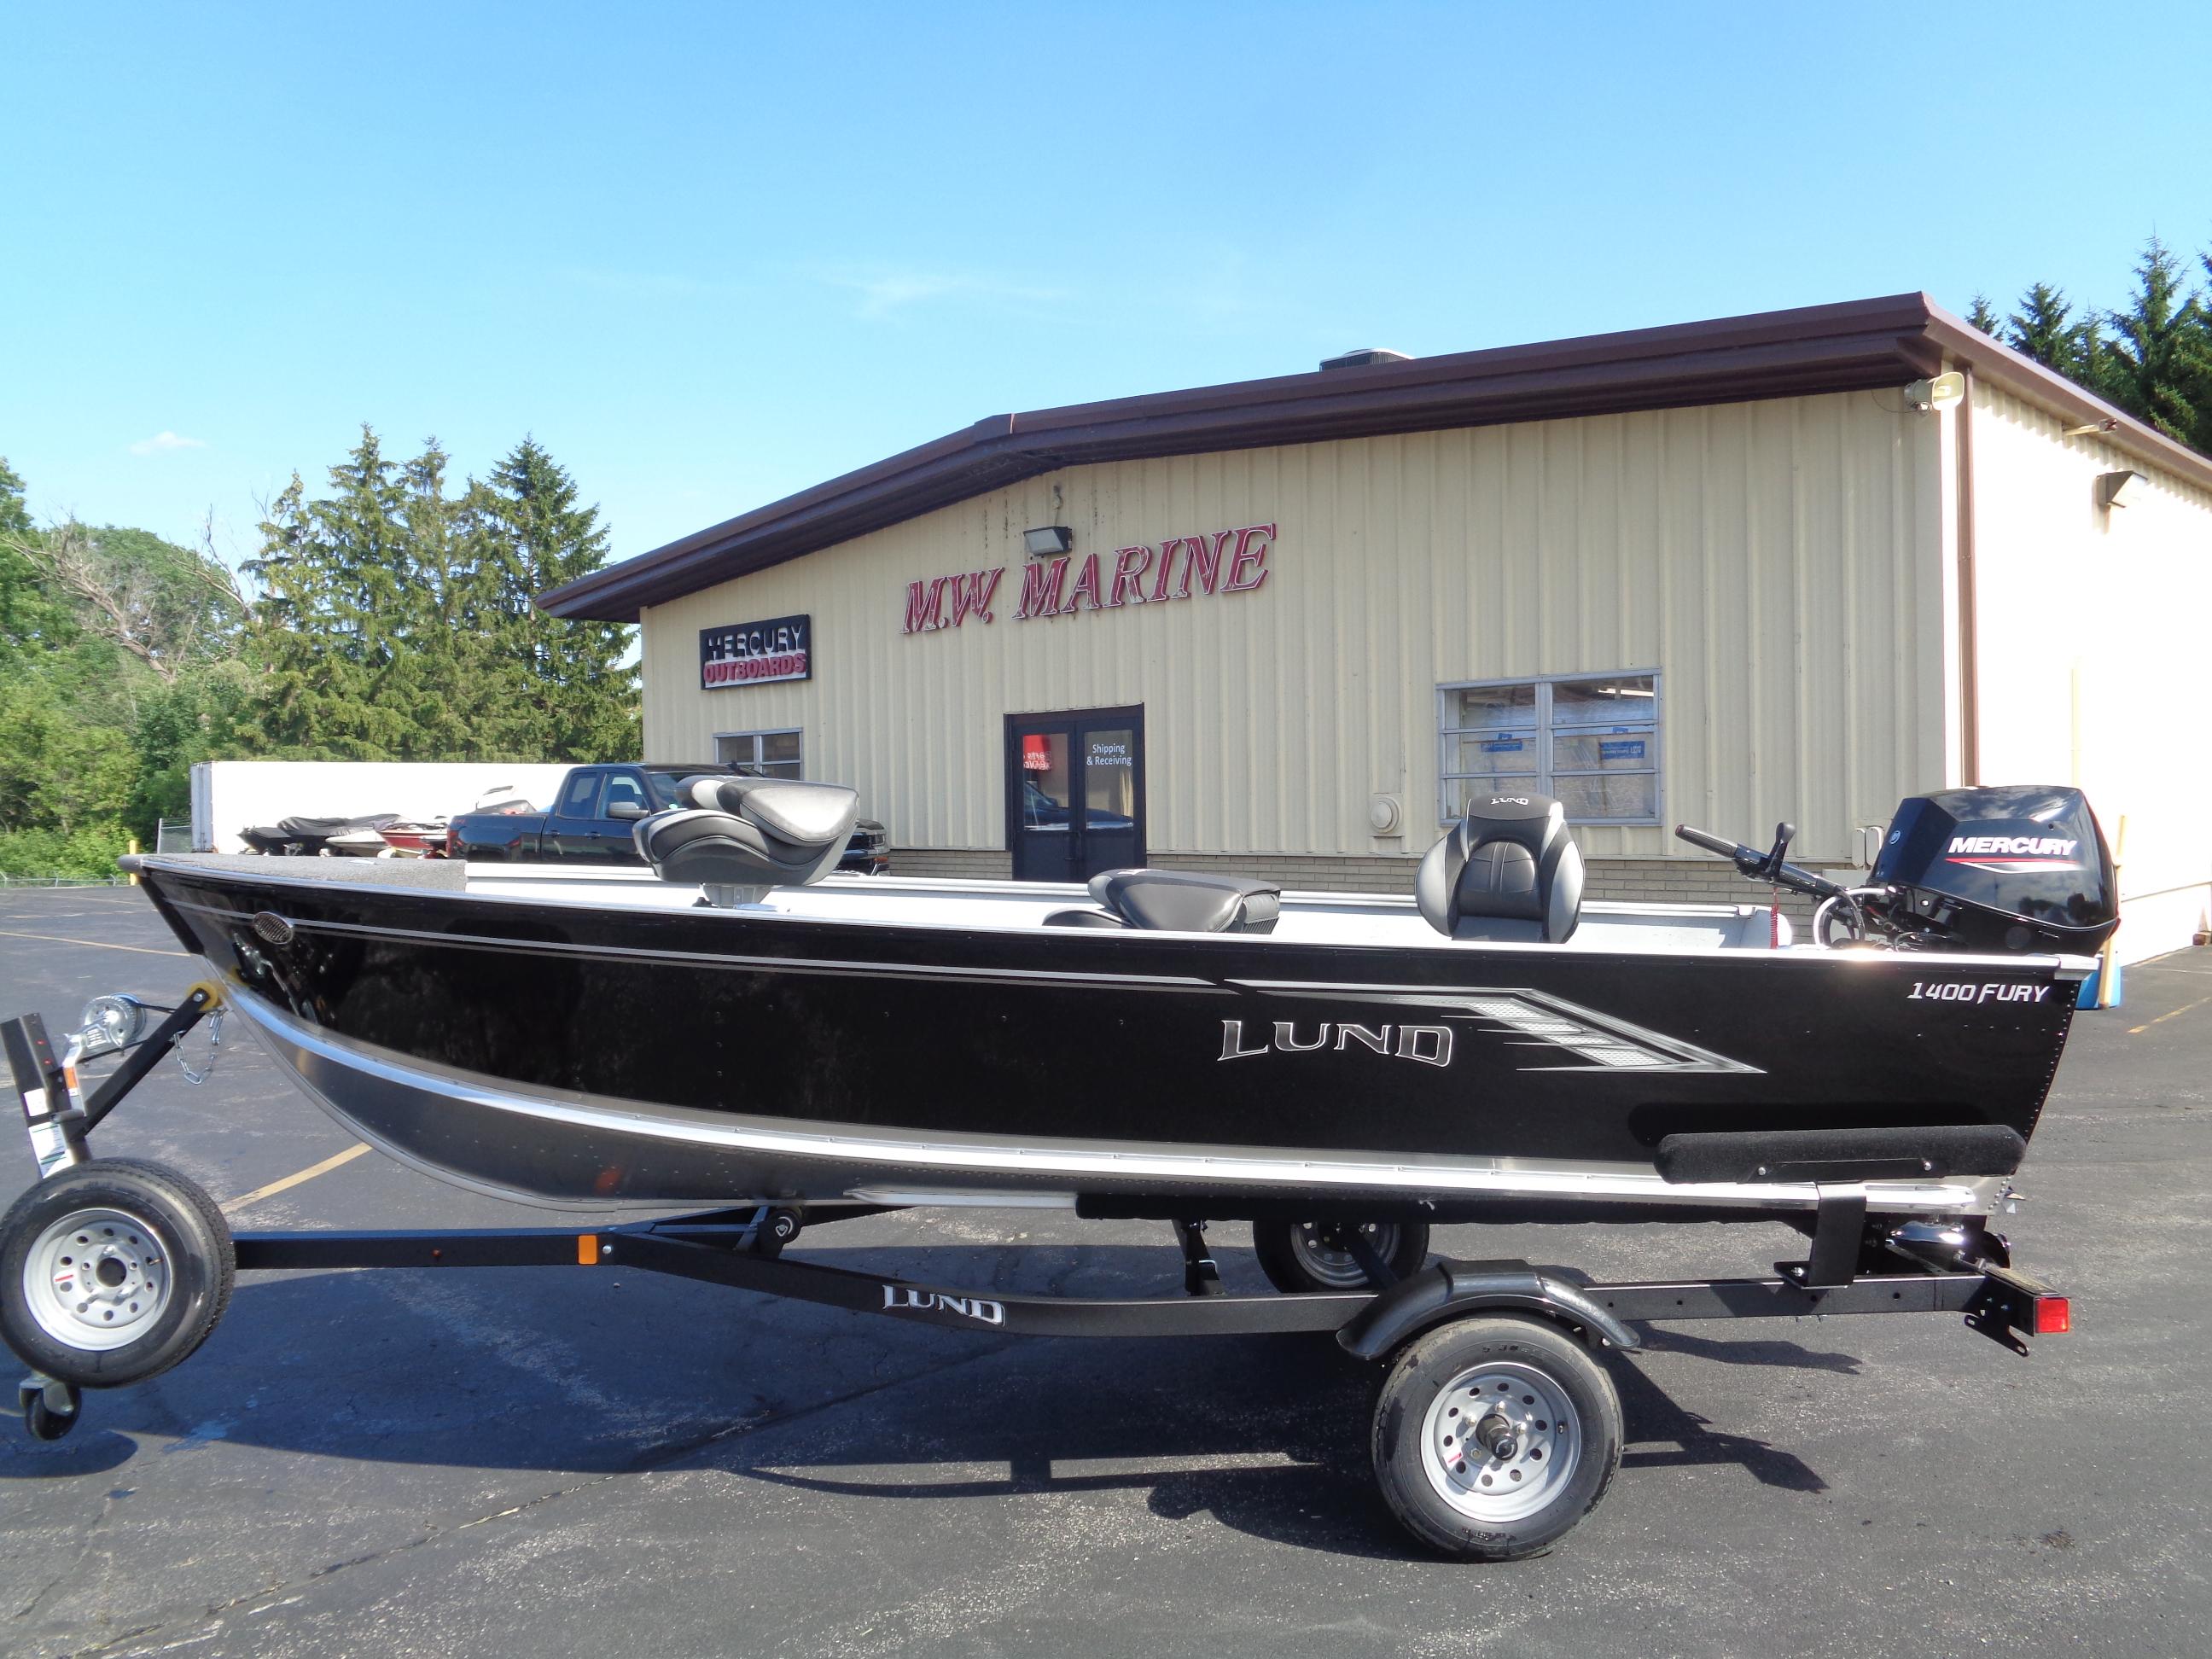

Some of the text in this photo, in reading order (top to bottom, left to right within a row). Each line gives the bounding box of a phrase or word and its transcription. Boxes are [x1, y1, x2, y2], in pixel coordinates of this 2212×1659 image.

[1011, 522, 1277, 620] MARINE
[706, 624, 804, 661] MERCURY
[703, 653, 806, 683] OUTBOARDS
[1086, 754, 1132, 766] & Receiving
[1091, 742, 1126, 755] Shipping
[1947, 837, 2077, 856] MERCURY
[1906, 982, 2051, 1005] 1400 FURY
[1217, 1020, 1453, 1068] LUND
[882, 1284, 1006, 1328] LUND
